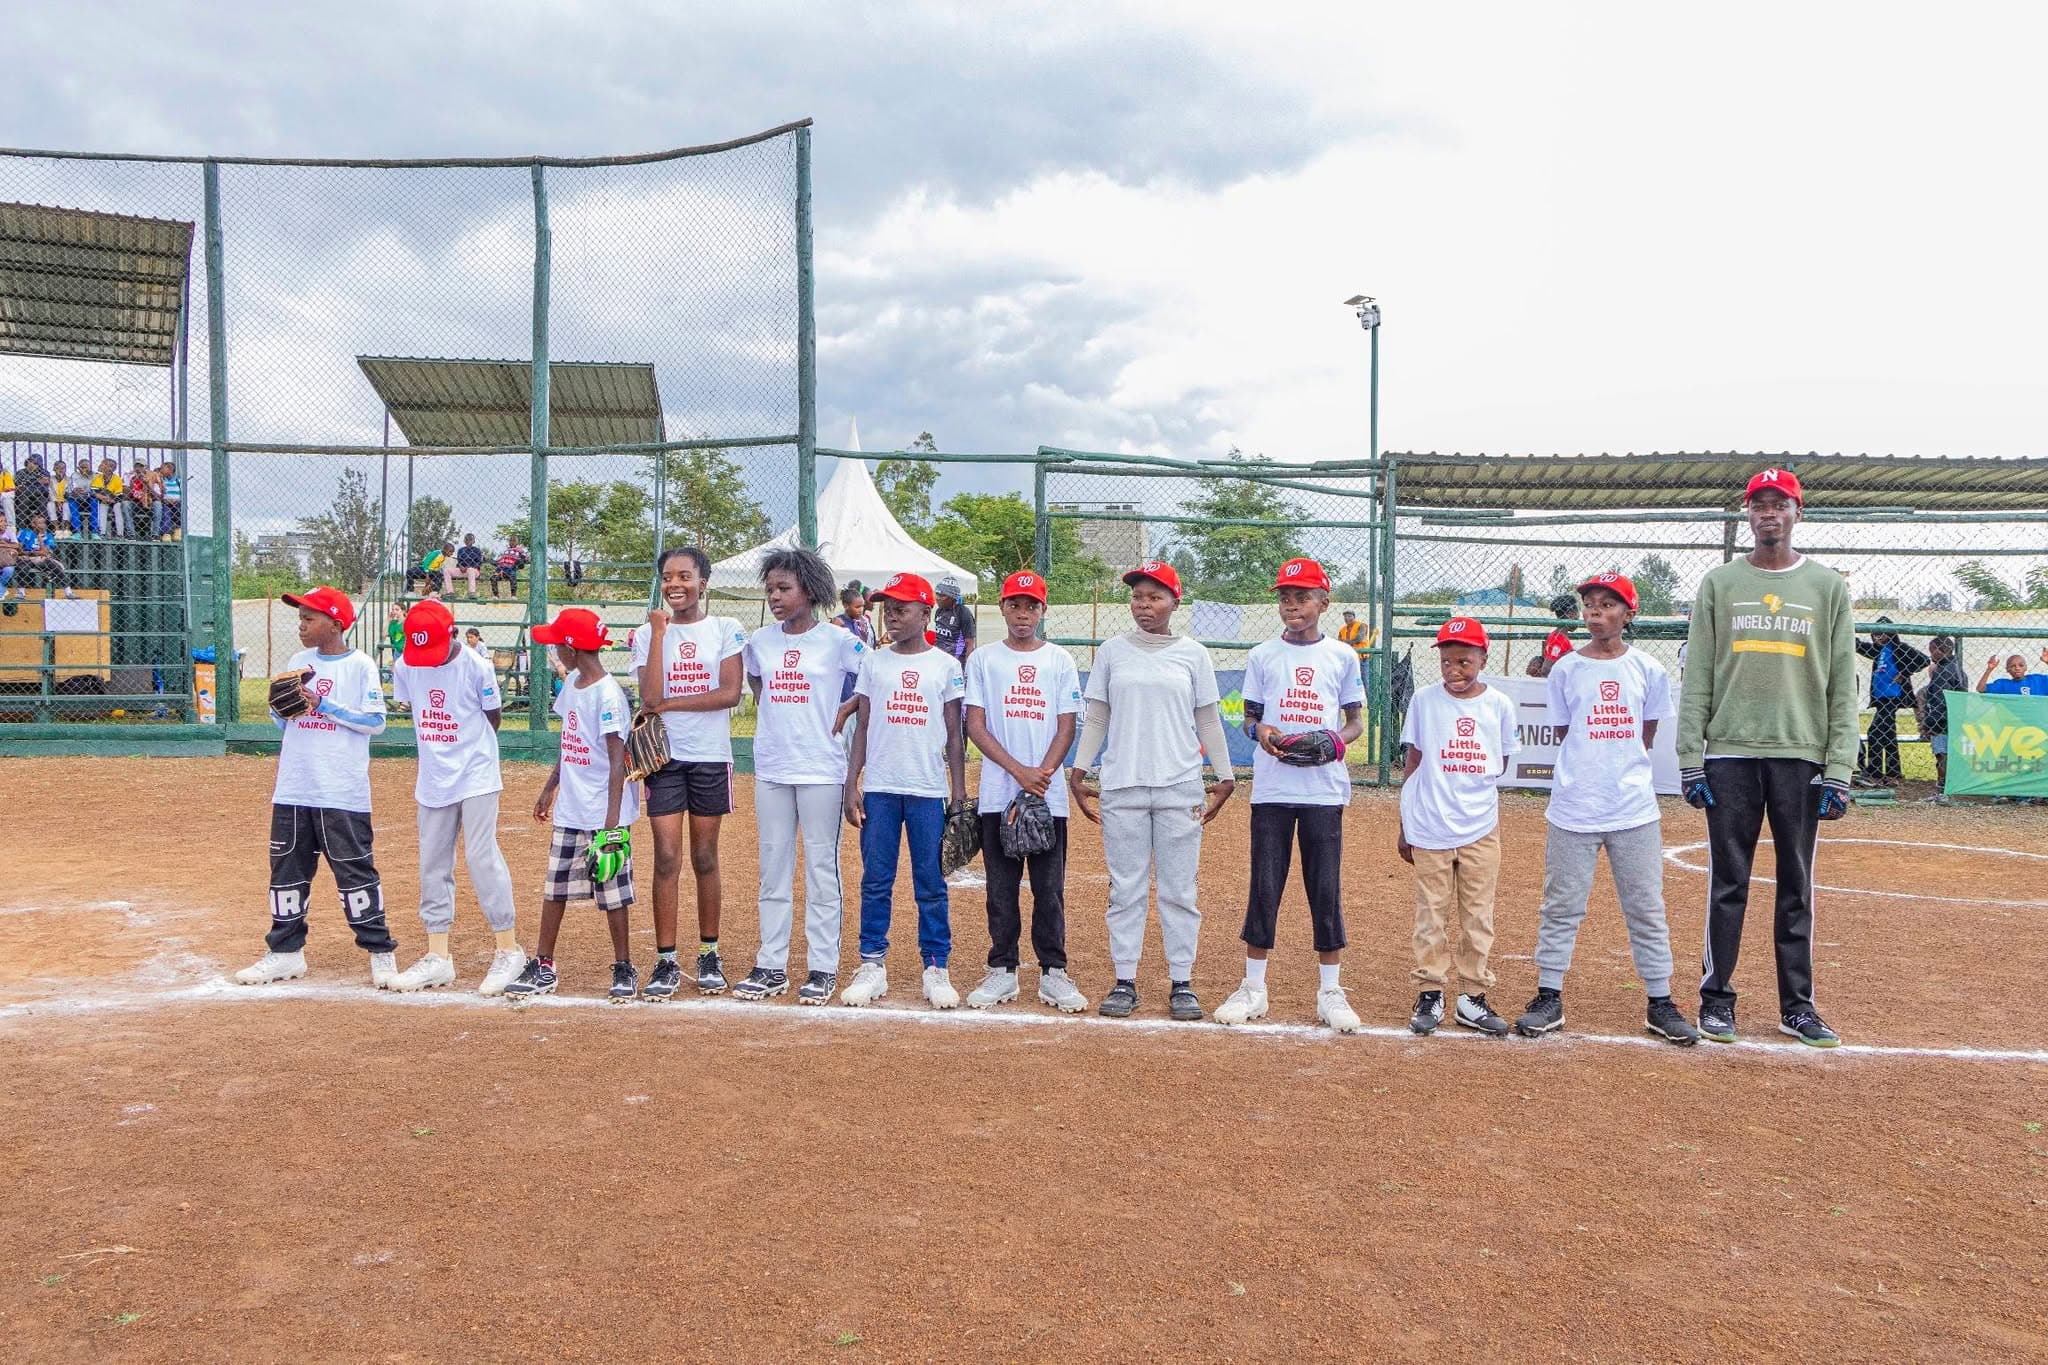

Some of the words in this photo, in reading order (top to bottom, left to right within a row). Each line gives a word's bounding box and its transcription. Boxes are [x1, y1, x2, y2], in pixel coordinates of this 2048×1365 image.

[1017, 575, 1034, 588] W
[1732, 614, 1773, 632] ANGELS
[1773, 616, 1790, 631] AT
[1790, 617, 1813, 636] BAT
[411, 630, 429, 646] W
[672, 662, 704, 672] Little
[667, 671, 711, 683] League
[775, 670, 804, 681] Little
[669, 685, 710, 694] NAIROBI
[769, 680, 811, 692] League
[1010, 686, 1041, 697] Little
[770, 695, 809, 704] NAIROBI
[893, 691, 924, 703] Little
[1286, 688, 1319, 701] Little
[886, 701, 929, 714] League
[1004, 696, 1046, 708] League
[1279, 699, 1324, 712] League
[422, 709, 452, 721] Little
[1005, 710, 1045, 721] NAIROBI
[1593, 704, 1628, 715] Little
[887, 715, 927, 727] NAIROBI
[1280, 713, 1322, 725] NAIROBI
[1586, 715, 1635, 728] League
[297, 720, 337, 732] NAIROBI
[1517, 724, 1562, 747] ANGE
[1589, 730, 1635, 740] NAIROBI
[1448, 739, 1481, 750] Little
[1962, 723, 2048, 760] We
[561, 742, 590, 754] eague
[563, 755, 591, 766] AIROBI
[1440, 750, 1487, 762] League
[1442, 763, 1486, 774] NAIROBI
